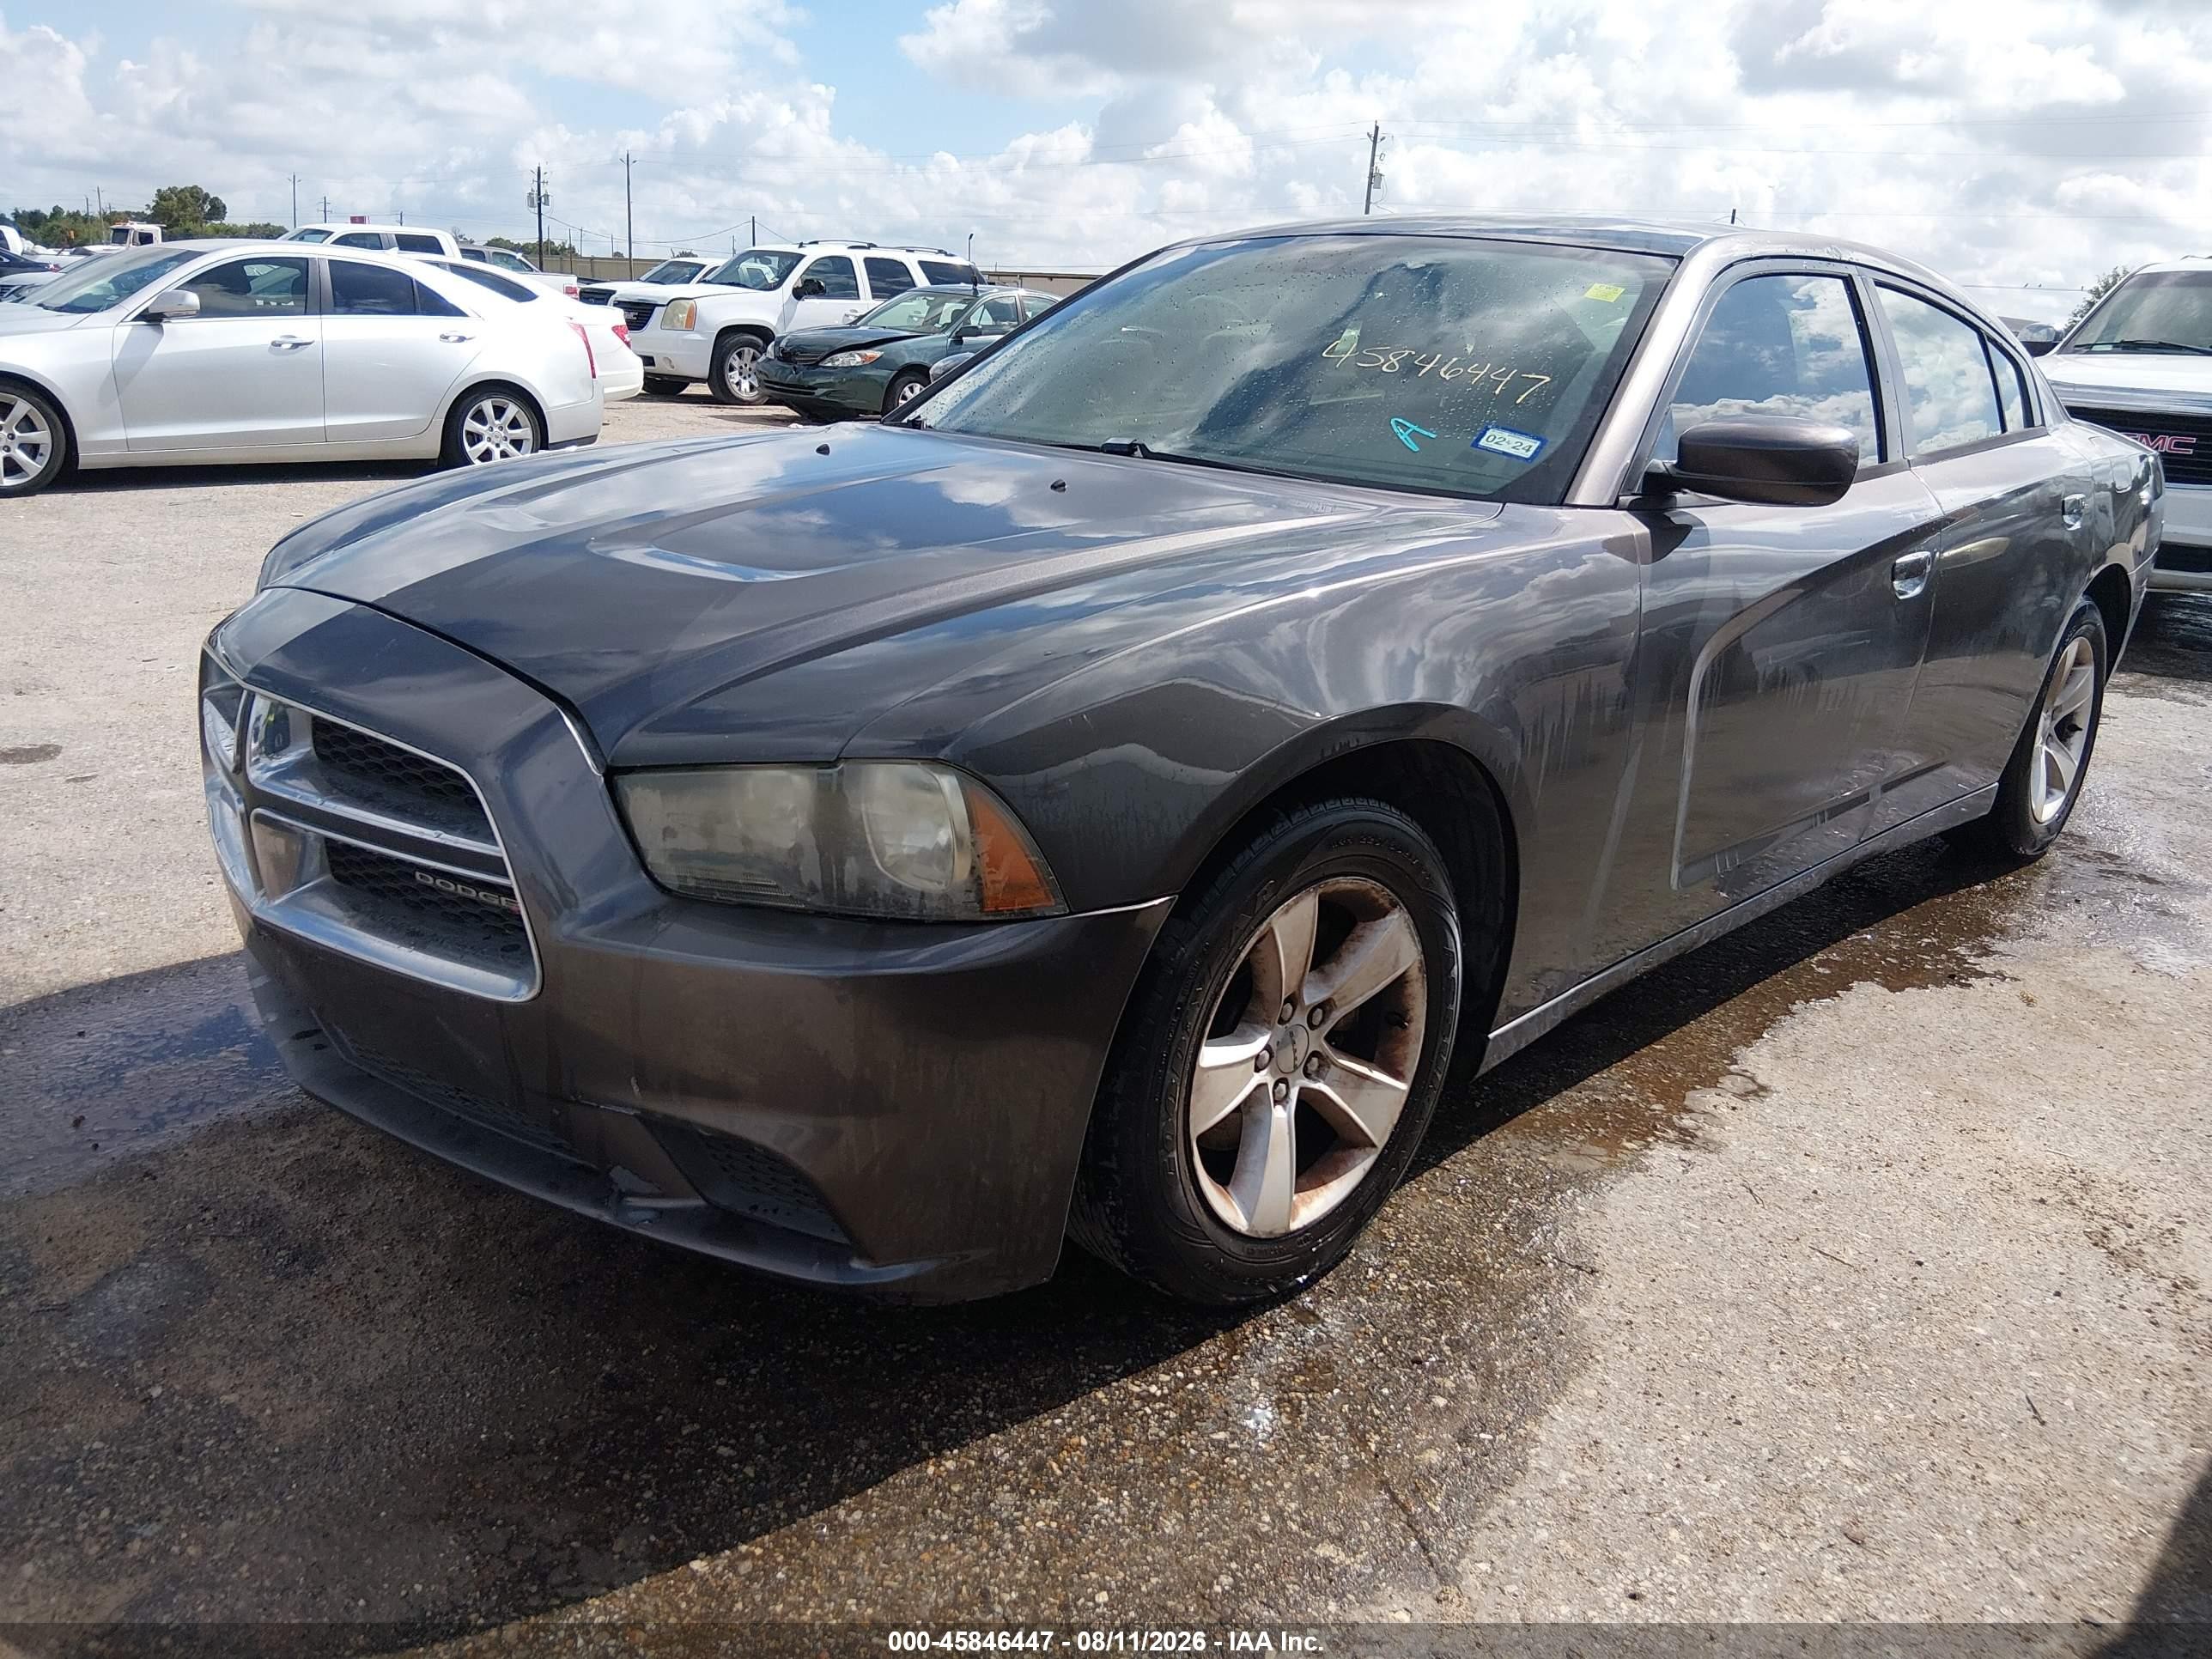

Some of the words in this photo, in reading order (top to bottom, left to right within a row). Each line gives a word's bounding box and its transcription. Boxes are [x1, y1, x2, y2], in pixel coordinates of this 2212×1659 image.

[1322, 340, 1551, 404] 45846447
[1390, 417, 1437, 452] A
[415, 871, 520, 908] DODGE
